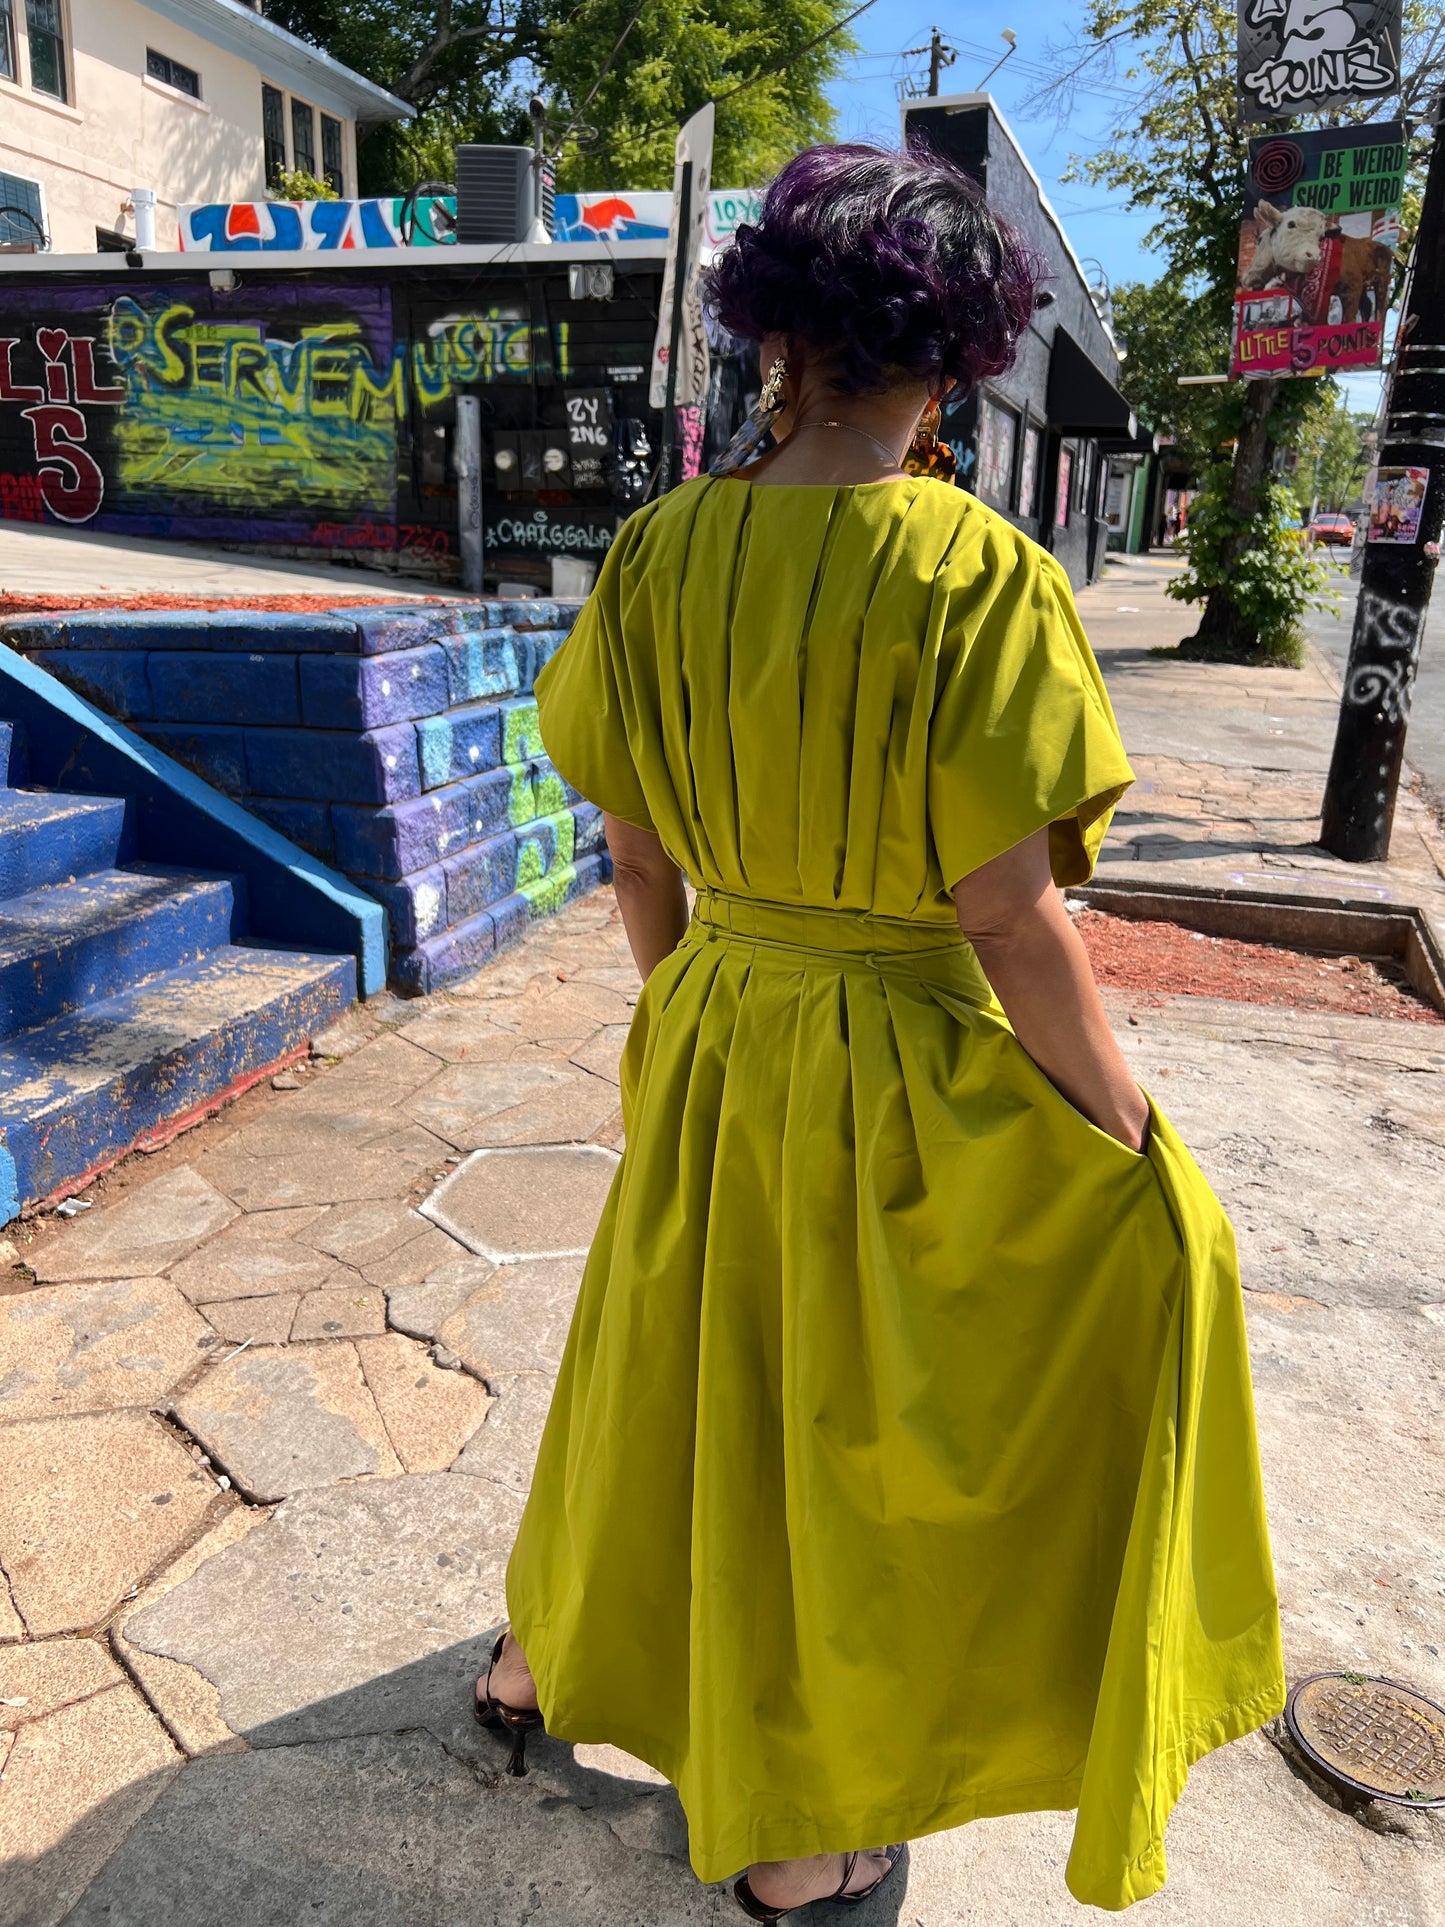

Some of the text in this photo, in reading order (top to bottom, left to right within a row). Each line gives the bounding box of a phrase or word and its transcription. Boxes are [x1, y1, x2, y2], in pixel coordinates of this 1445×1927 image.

[1250, 40, 1392, 105] POINTS
[1323, 144, 1404, 180] BE WEIRD
[1296, 176, 1401, 210] SHOP WEIRD
[1239, 325, 1377, 371] LITTLE 5 POINTS
